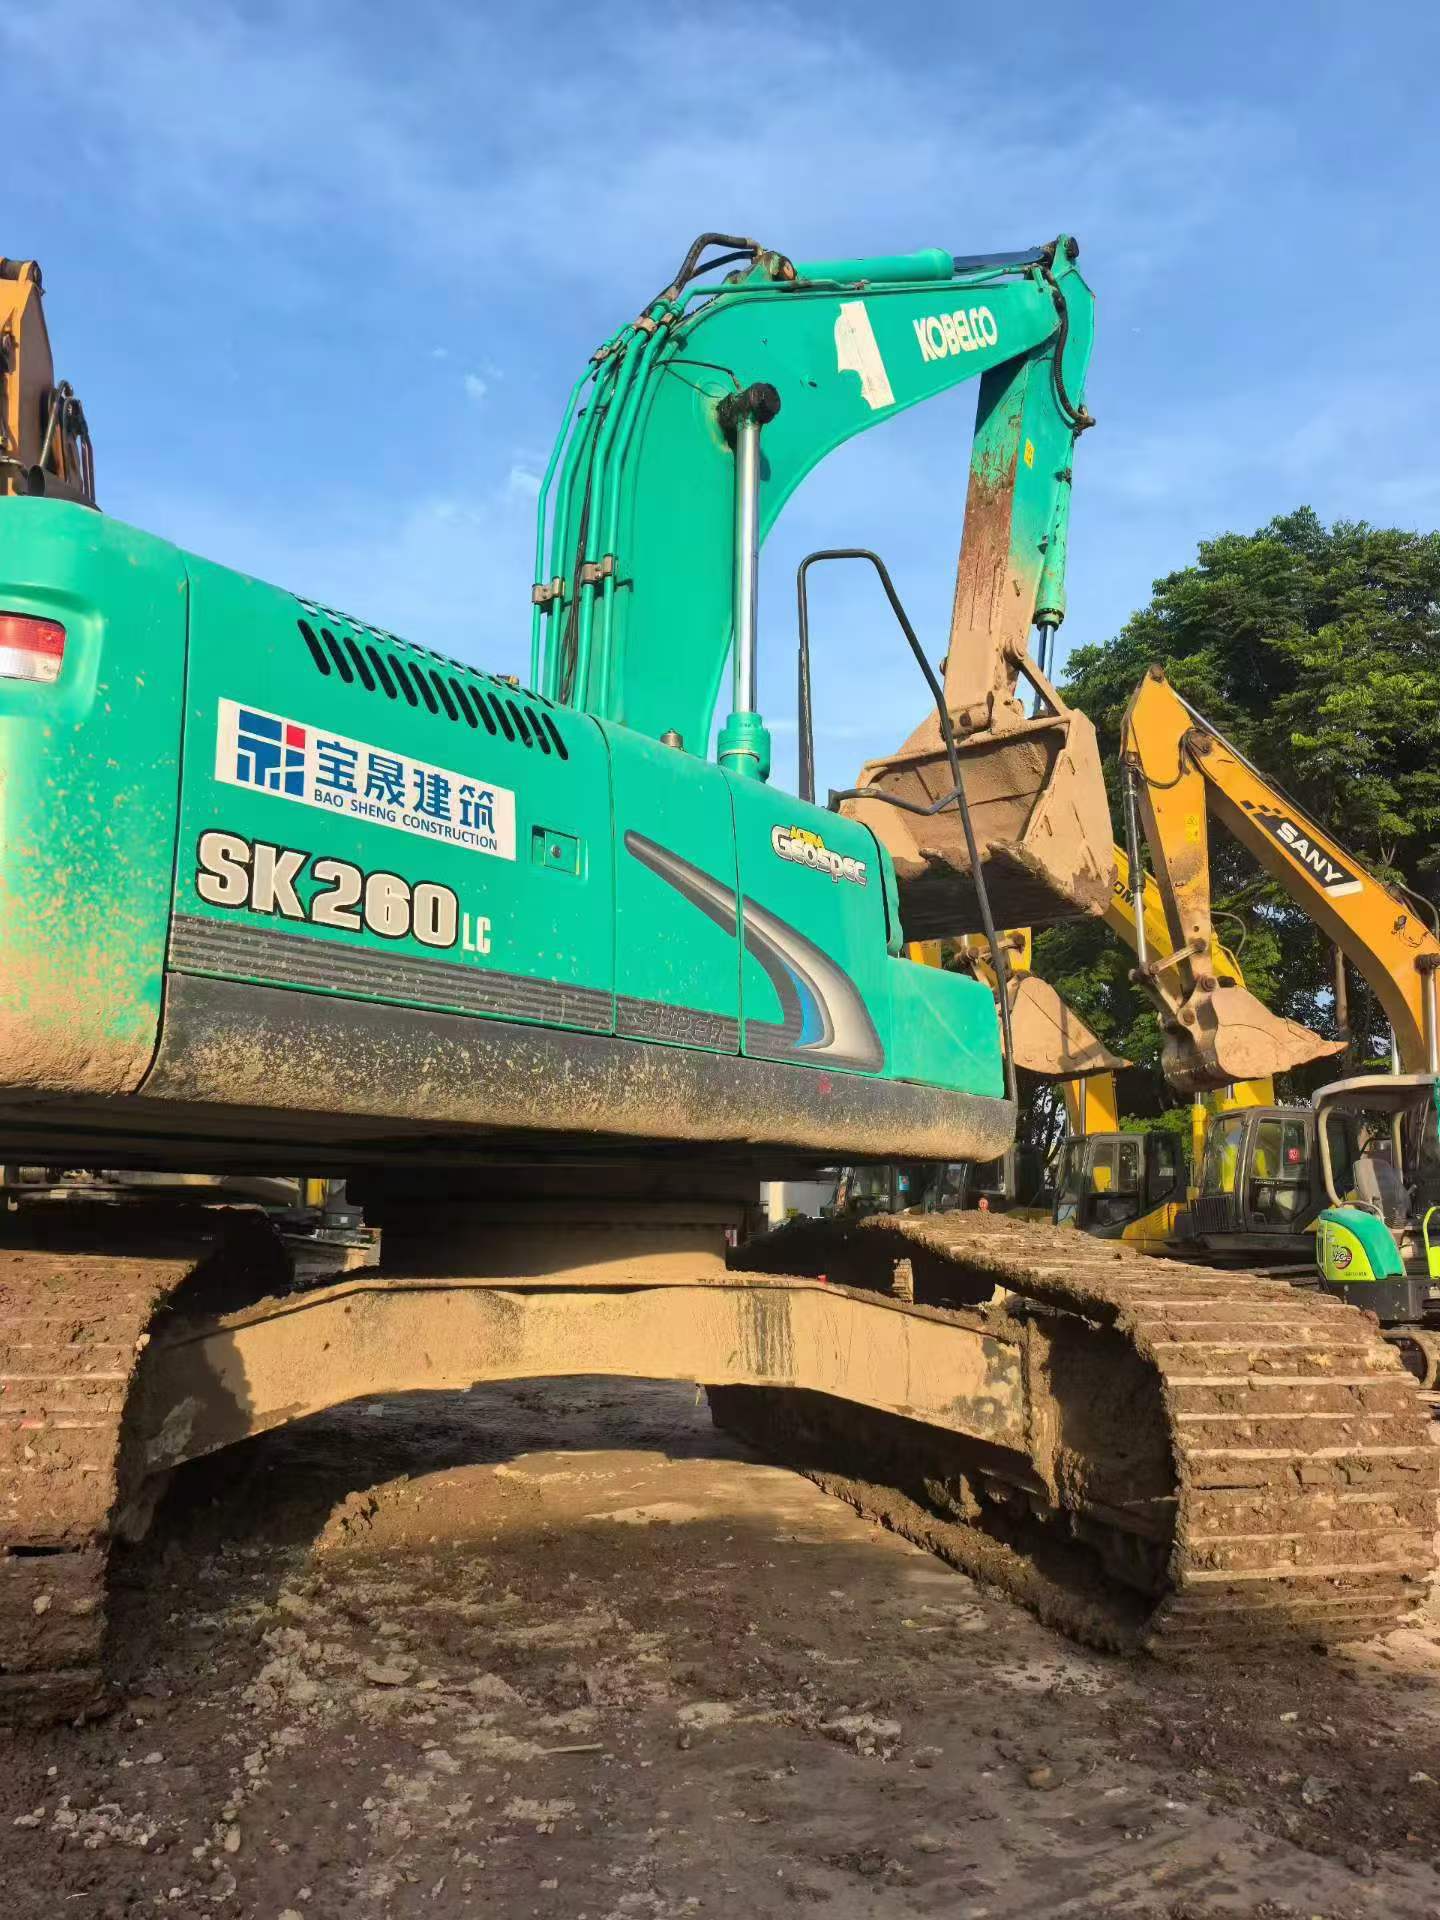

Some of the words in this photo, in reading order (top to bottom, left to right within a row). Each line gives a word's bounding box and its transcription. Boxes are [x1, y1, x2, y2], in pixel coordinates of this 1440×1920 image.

[912, 305, 998, 362] KOBELCO
[315, 738, 496, 835] 宝晟建筑
[314, 789, 344, 808] BAO
[350, 799, 396, 823] SHENG
[402, 814, 498, 851] CONSTRUCTION
[1276, 822, 1344, 882] SANY
